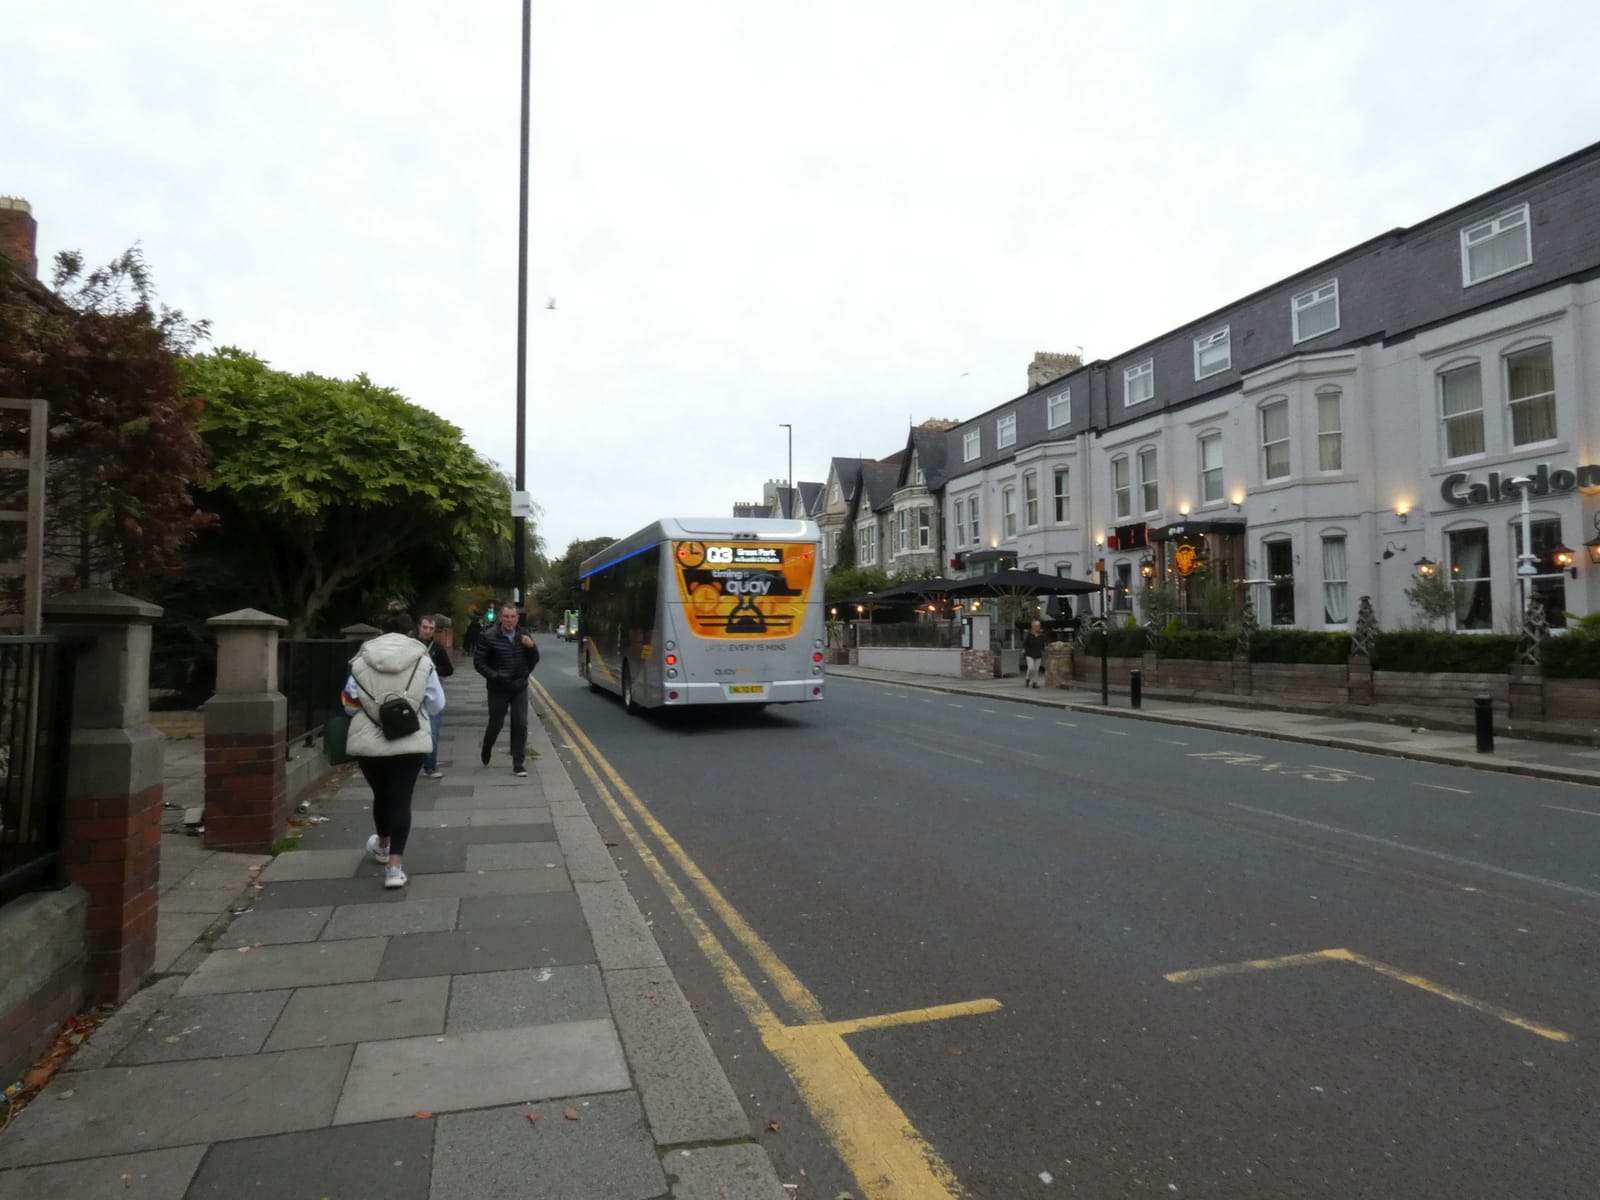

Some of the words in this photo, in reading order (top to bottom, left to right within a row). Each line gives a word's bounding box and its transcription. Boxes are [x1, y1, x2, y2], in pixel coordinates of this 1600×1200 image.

[706, 547, 733, 563] Q3
[712, 569, 743, 580] timing
[726, 580, 771, 595] quay
[728, 644, 753, 652] EVERY
